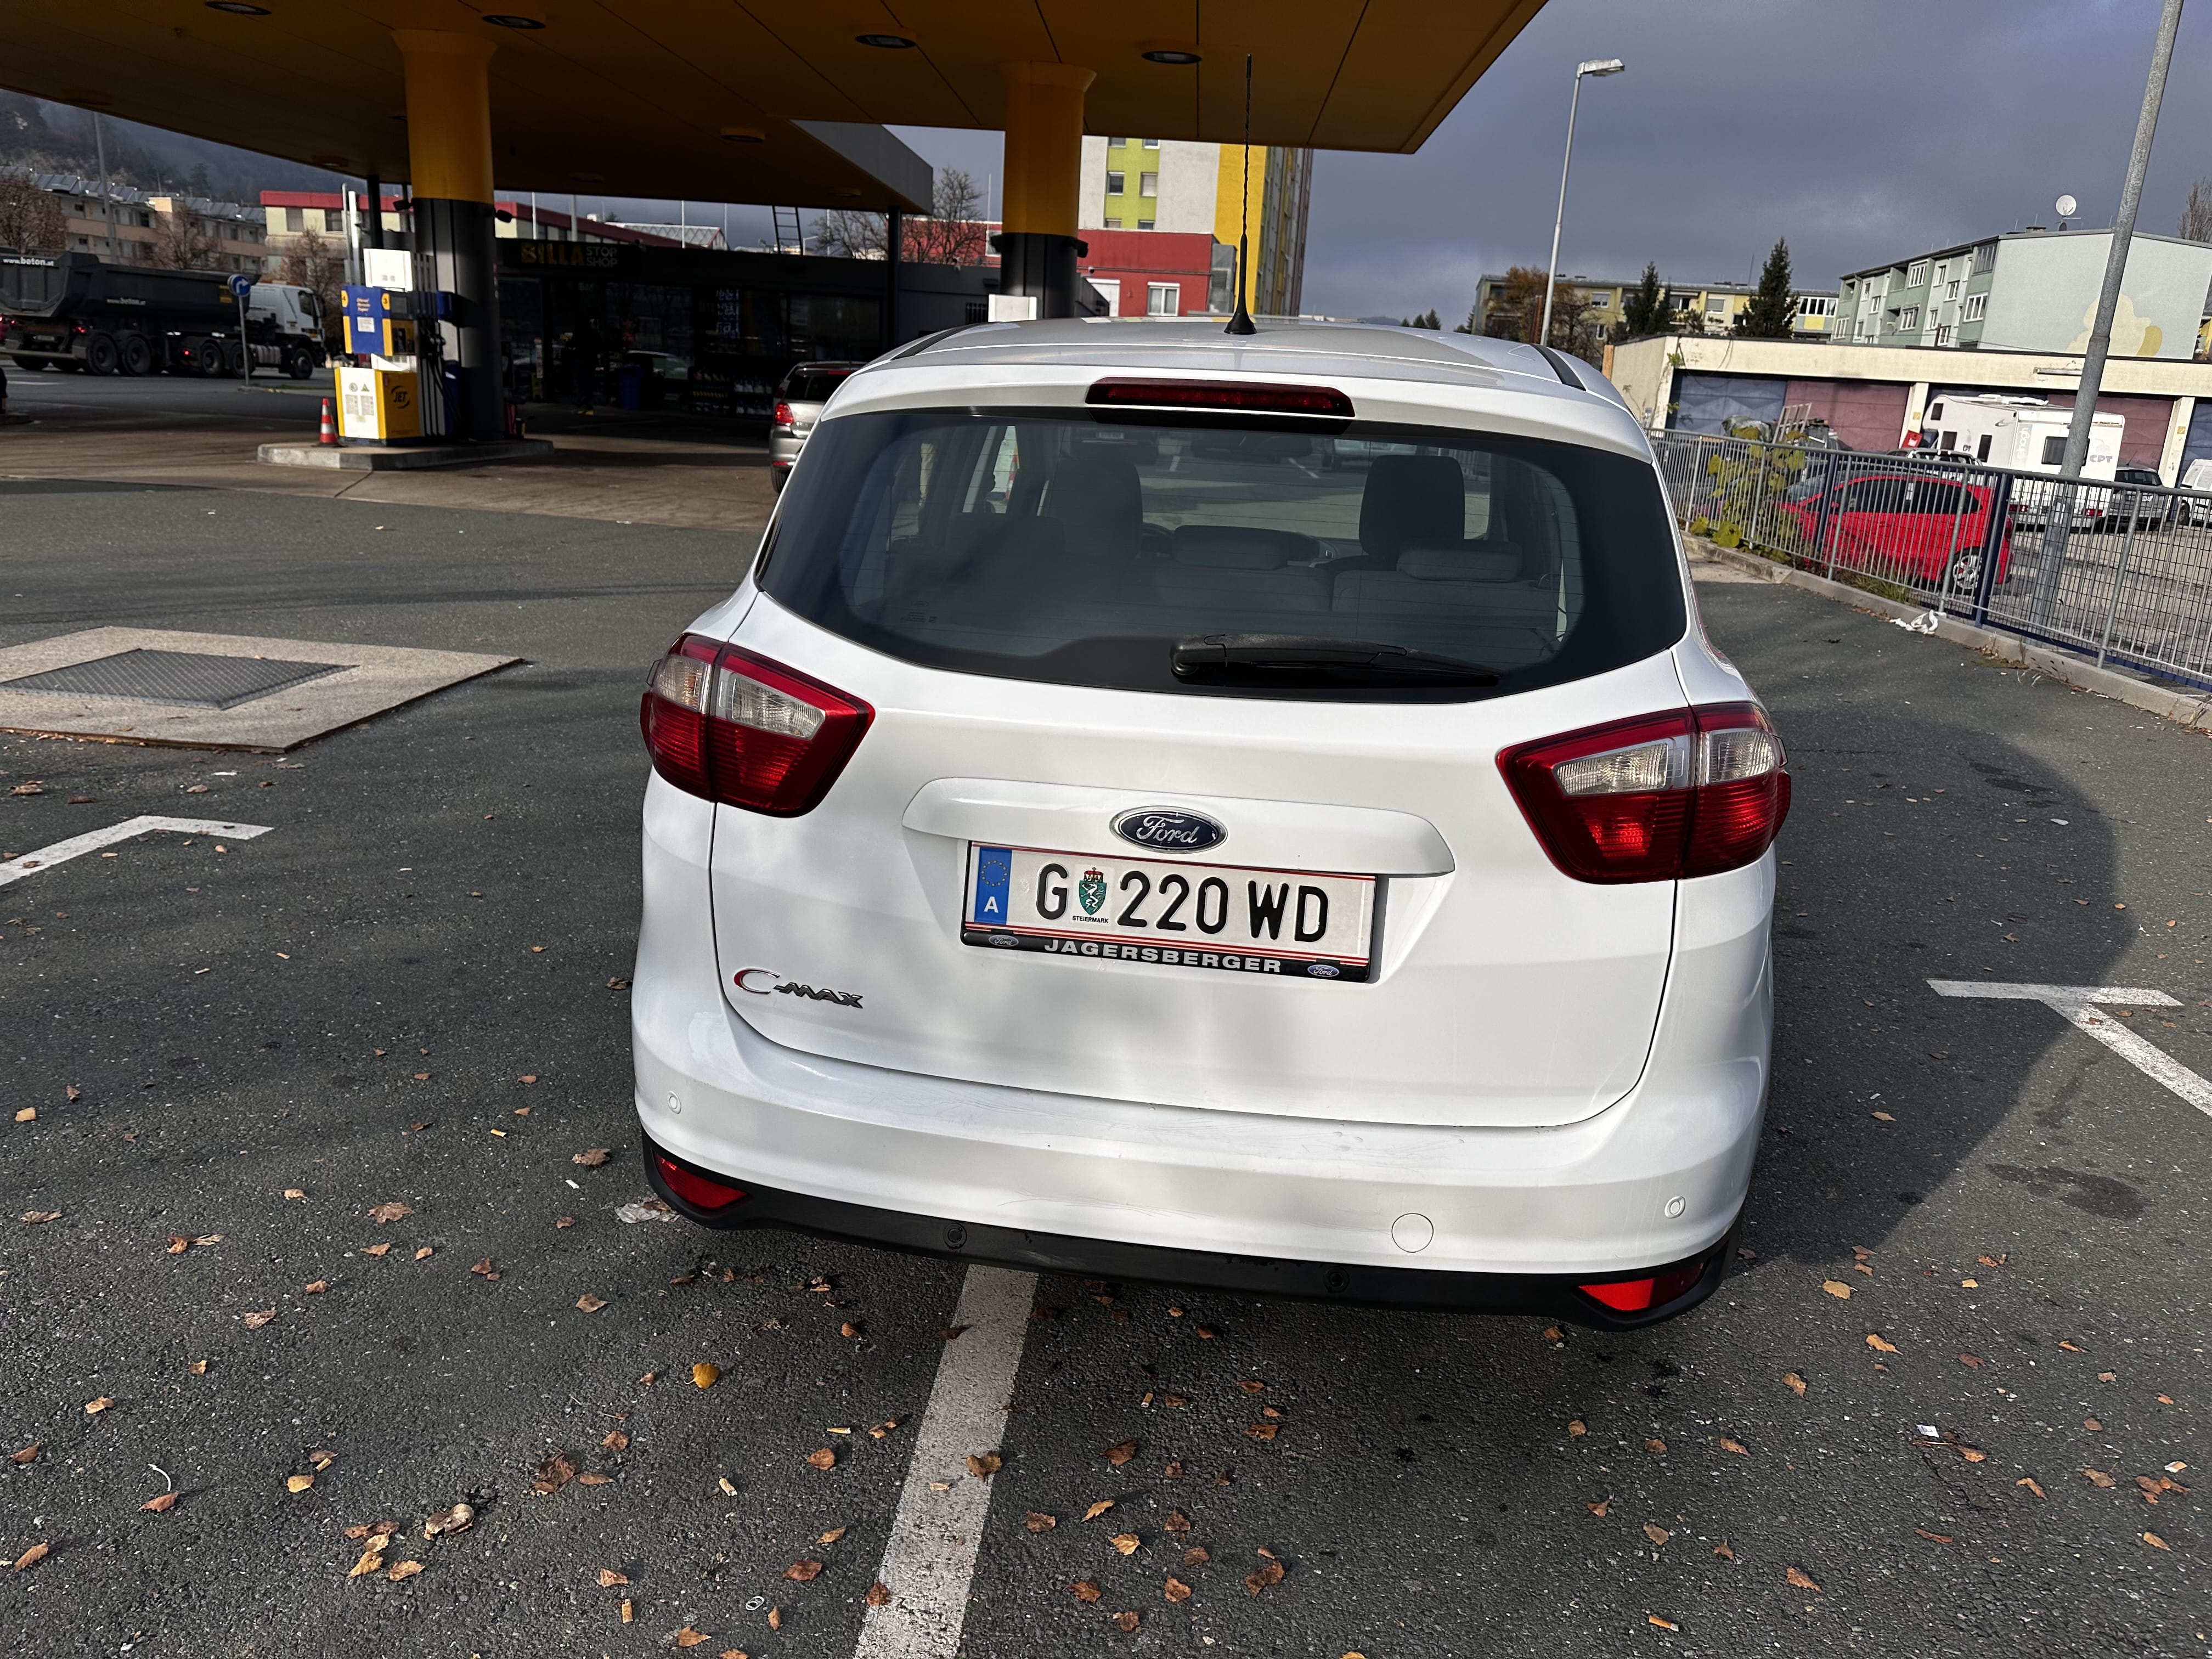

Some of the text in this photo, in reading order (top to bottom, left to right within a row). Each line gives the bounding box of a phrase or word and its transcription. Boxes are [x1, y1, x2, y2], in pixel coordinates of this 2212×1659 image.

[521, 242, 585, 266] BILLA
[585, 246, 618, 257] STOP
[3, 256, 54, 266] www.beton.at
[586, 257, 618, 267] SHOP
[393, 391, 407, 403] JET
[2090, 454, 2113, 463] CPT
[1136, 816, 1200, 844] Ford
[983, 896, 999, 913] A
[1036, 864, 1329, 943] G 220 WD
[1072, 915, 1109, 924] STEIERMARK
[1044, 939, 1282, 973] JAGERSBERGER
[733, 968, 864, 1009] C-MAX
